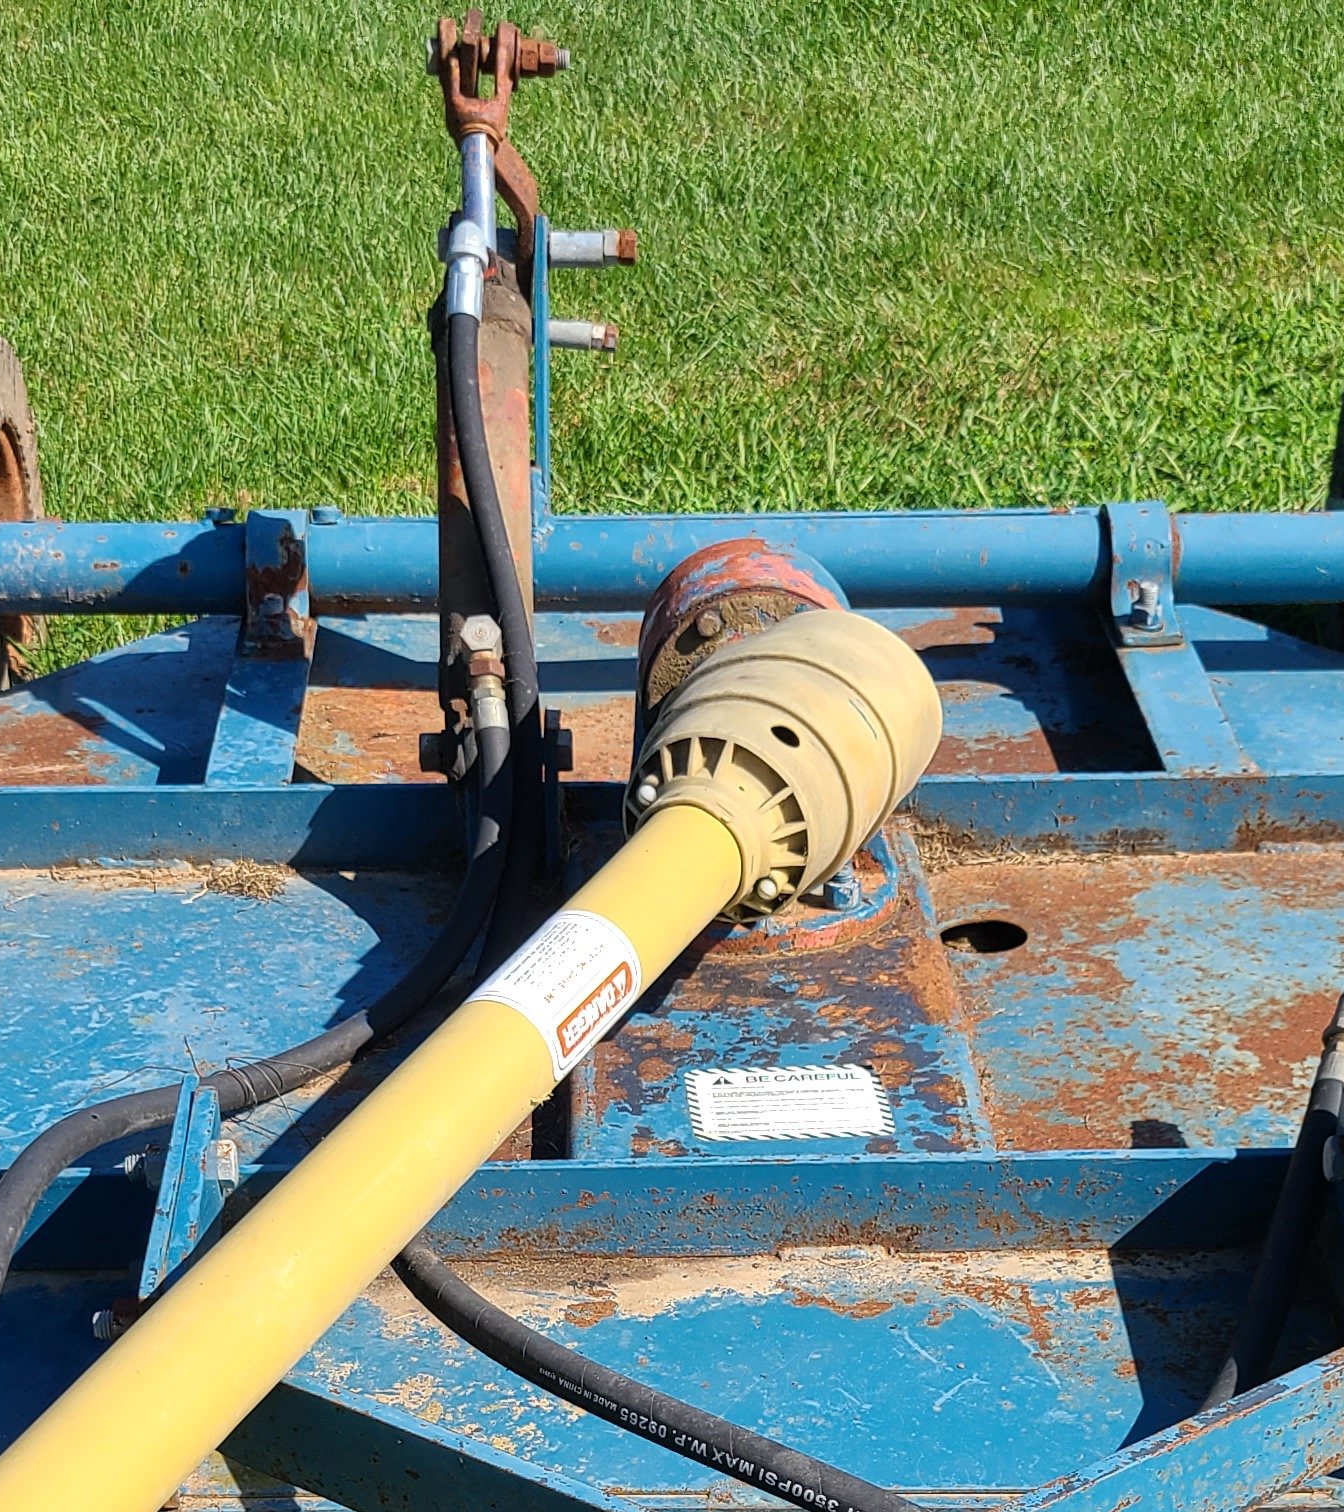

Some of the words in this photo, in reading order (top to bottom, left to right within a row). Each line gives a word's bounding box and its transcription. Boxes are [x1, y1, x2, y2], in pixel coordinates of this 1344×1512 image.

[562, 980, 622, 1047] DANGER
[744, 1074, 771, 1084] BE
[773, 1072, 862, 1083] CAREFUL
[557, 1377, 583, 1395] CHINA
[582, 1388, 594, 1401] IN
[592, 1392, 617, 1412] MADE
[619, 1406, 668, 1439] 09265
[711, 1446, 755, 1477] MAX
[758, 1466, 841, 1512] 3500PSI
